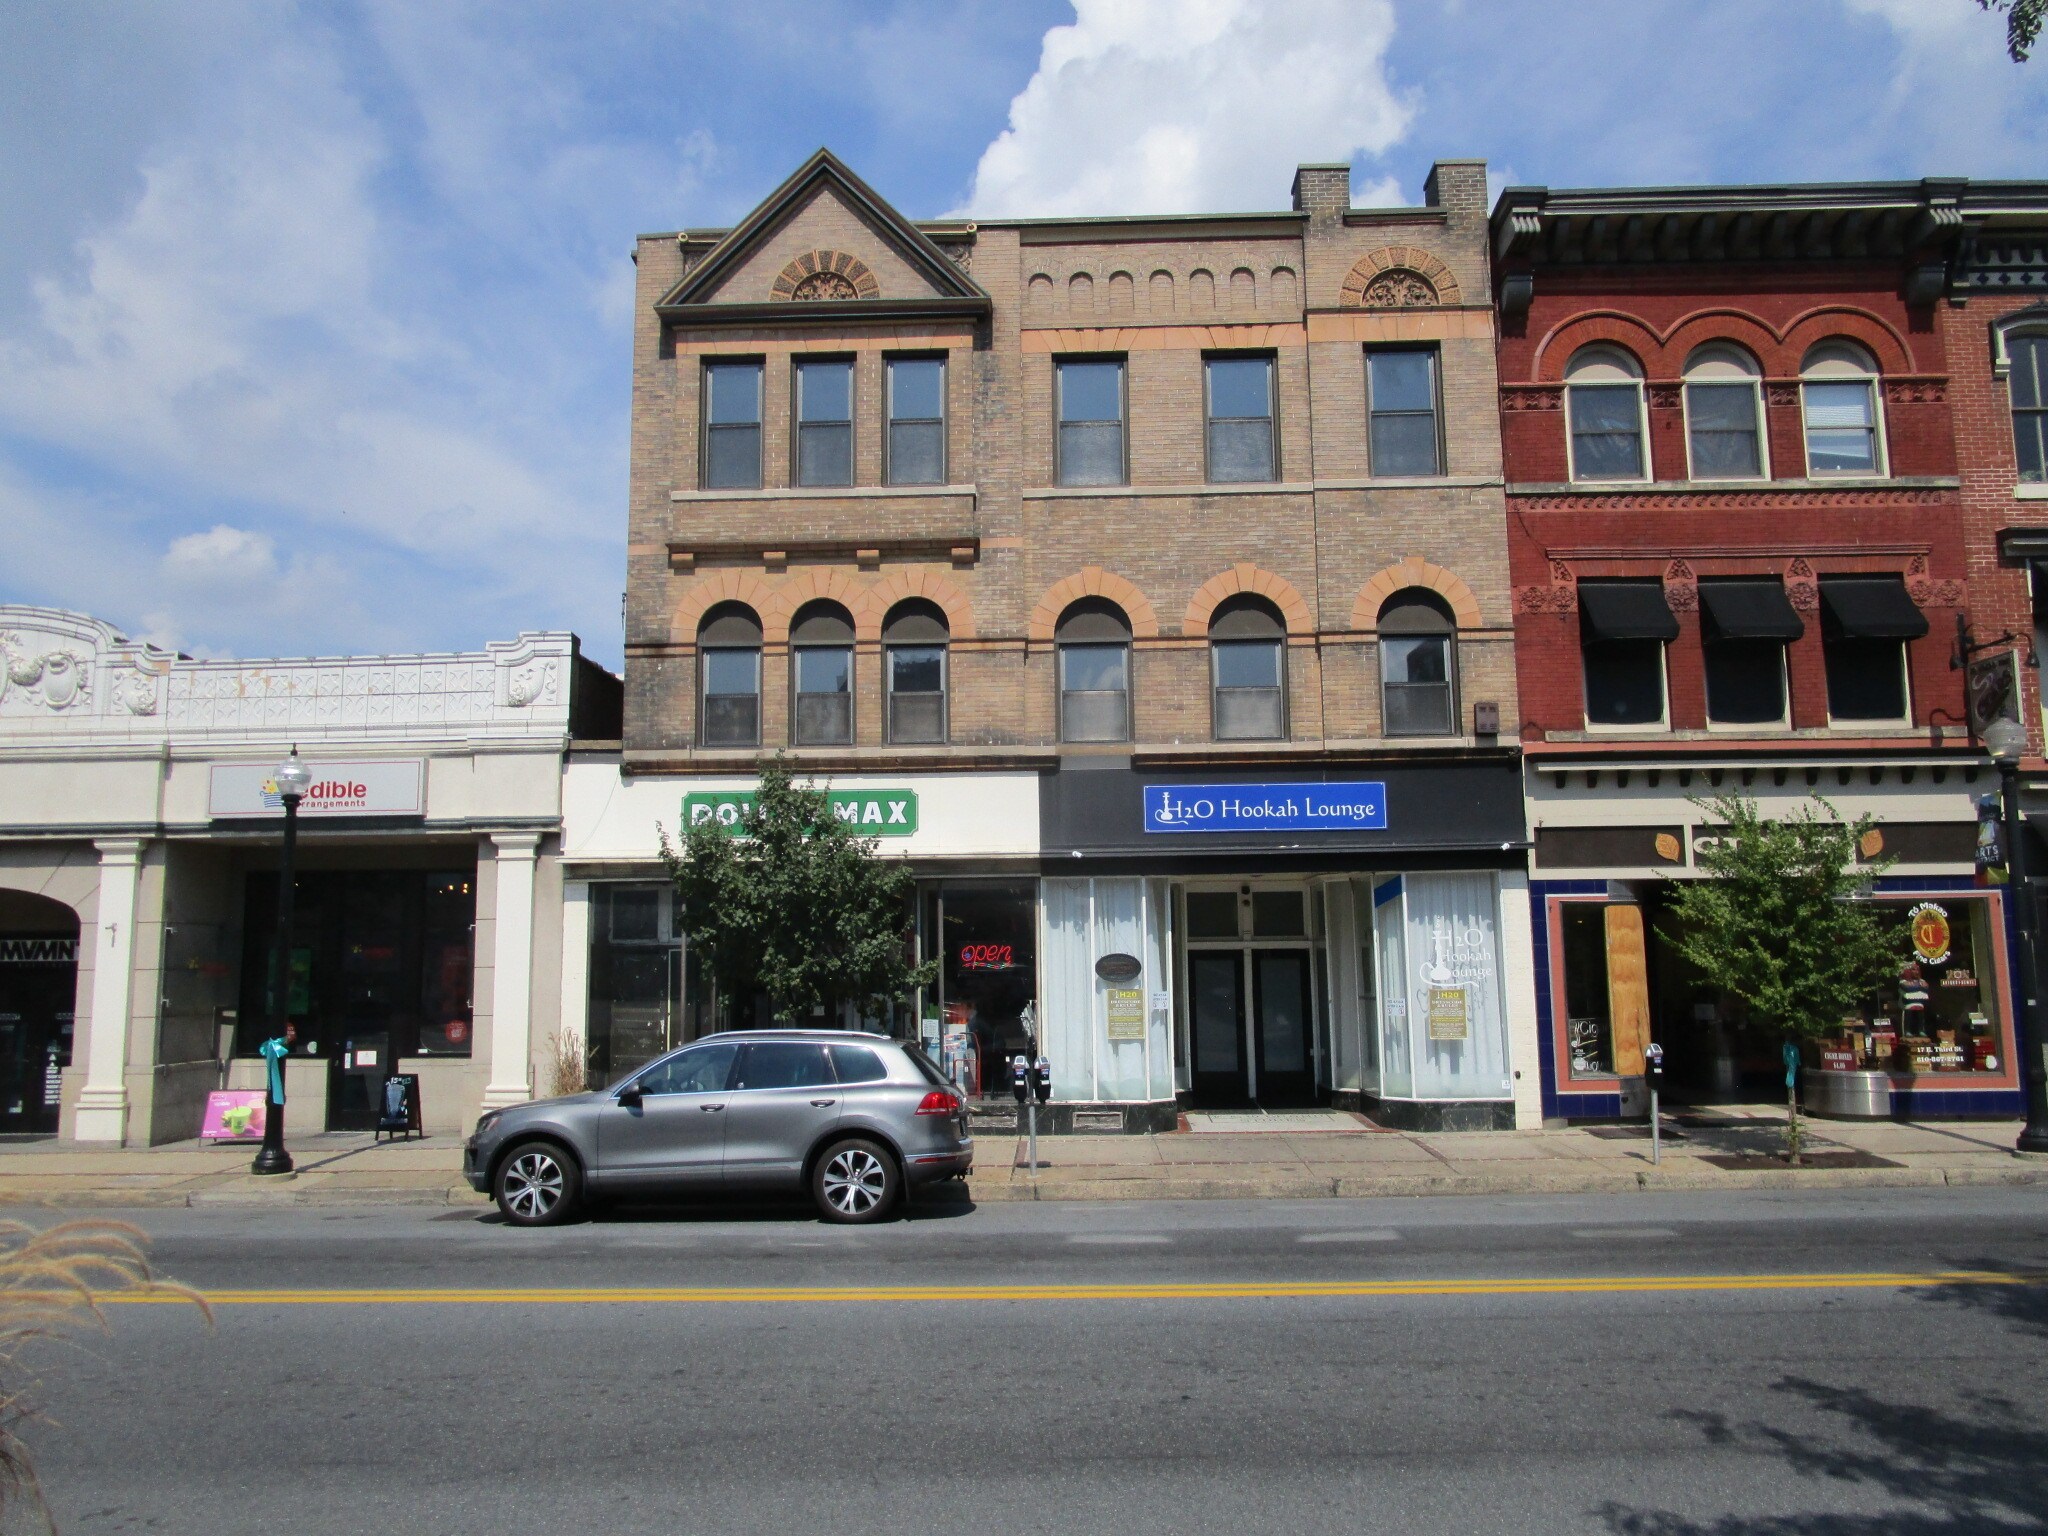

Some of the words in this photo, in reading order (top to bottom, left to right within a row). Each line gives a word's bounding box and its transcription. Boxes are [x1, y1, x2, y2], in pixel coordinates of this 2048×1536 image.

[299, 800, 366, 809] rrangements
[833, 801, 908, 825] MAX
[1164, 799, 1214, 819] H2O
[1222, 799, 1299, 819] Hookah
[1305, 797, 1376, 821] Lounge
[961, 944, 1012, 969] open
[1447, 966, 1492, 979] ounge
